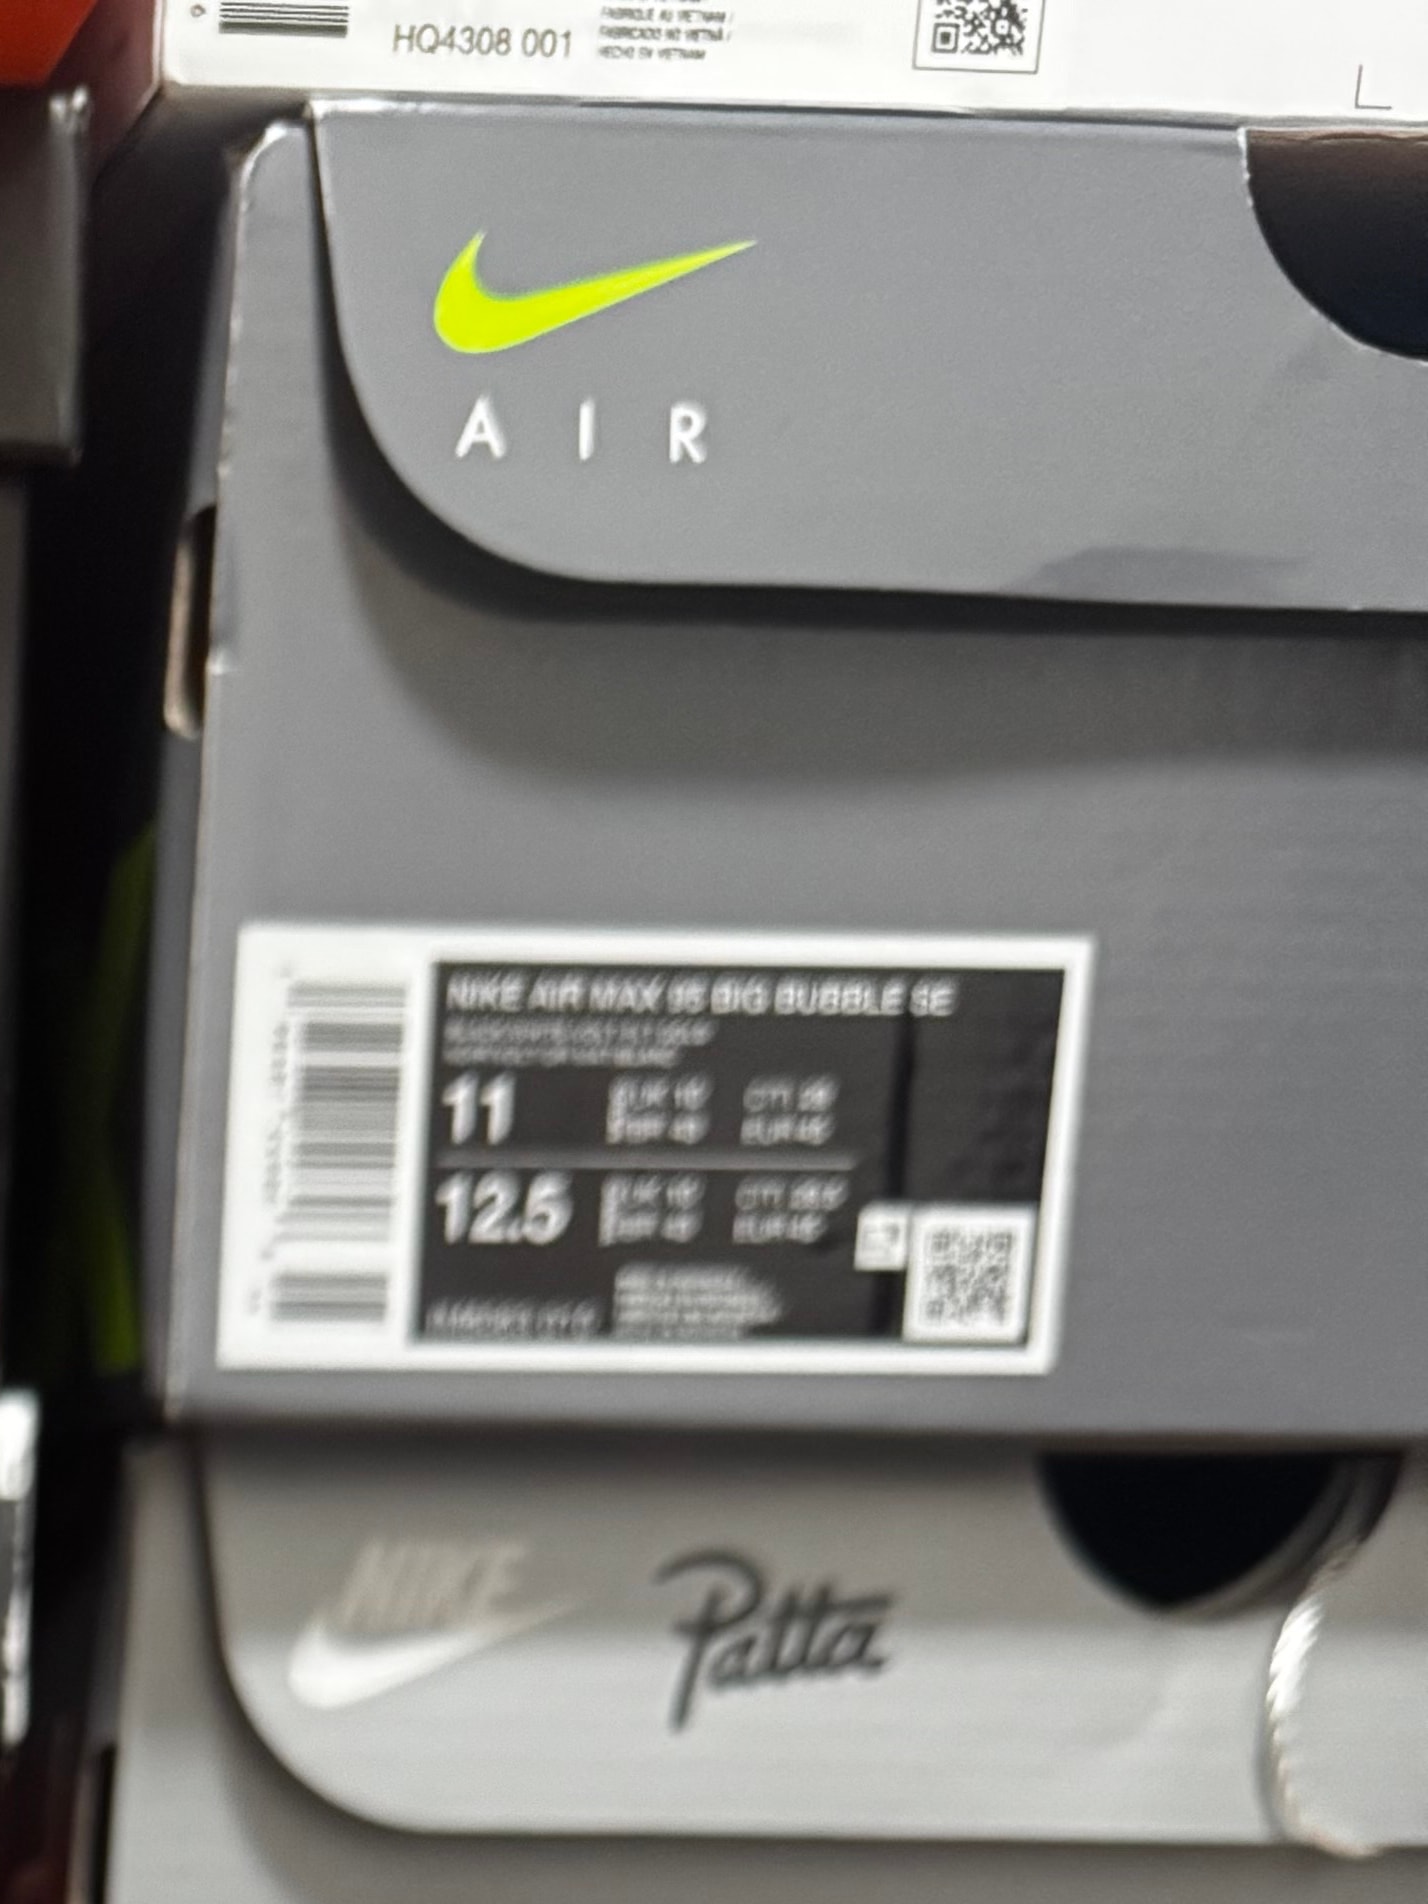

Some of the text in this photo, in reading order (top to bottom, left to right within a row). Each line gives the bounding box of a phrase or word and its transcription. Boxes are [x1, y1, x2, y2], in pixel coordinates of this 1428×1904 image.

[392, 23, 573, 58] HQ4308 001
[442, 1072, 516, 1146] 11
[342, 1537, 531, 1634] NIKE
[653, 1547, 898, 1734] Patta
